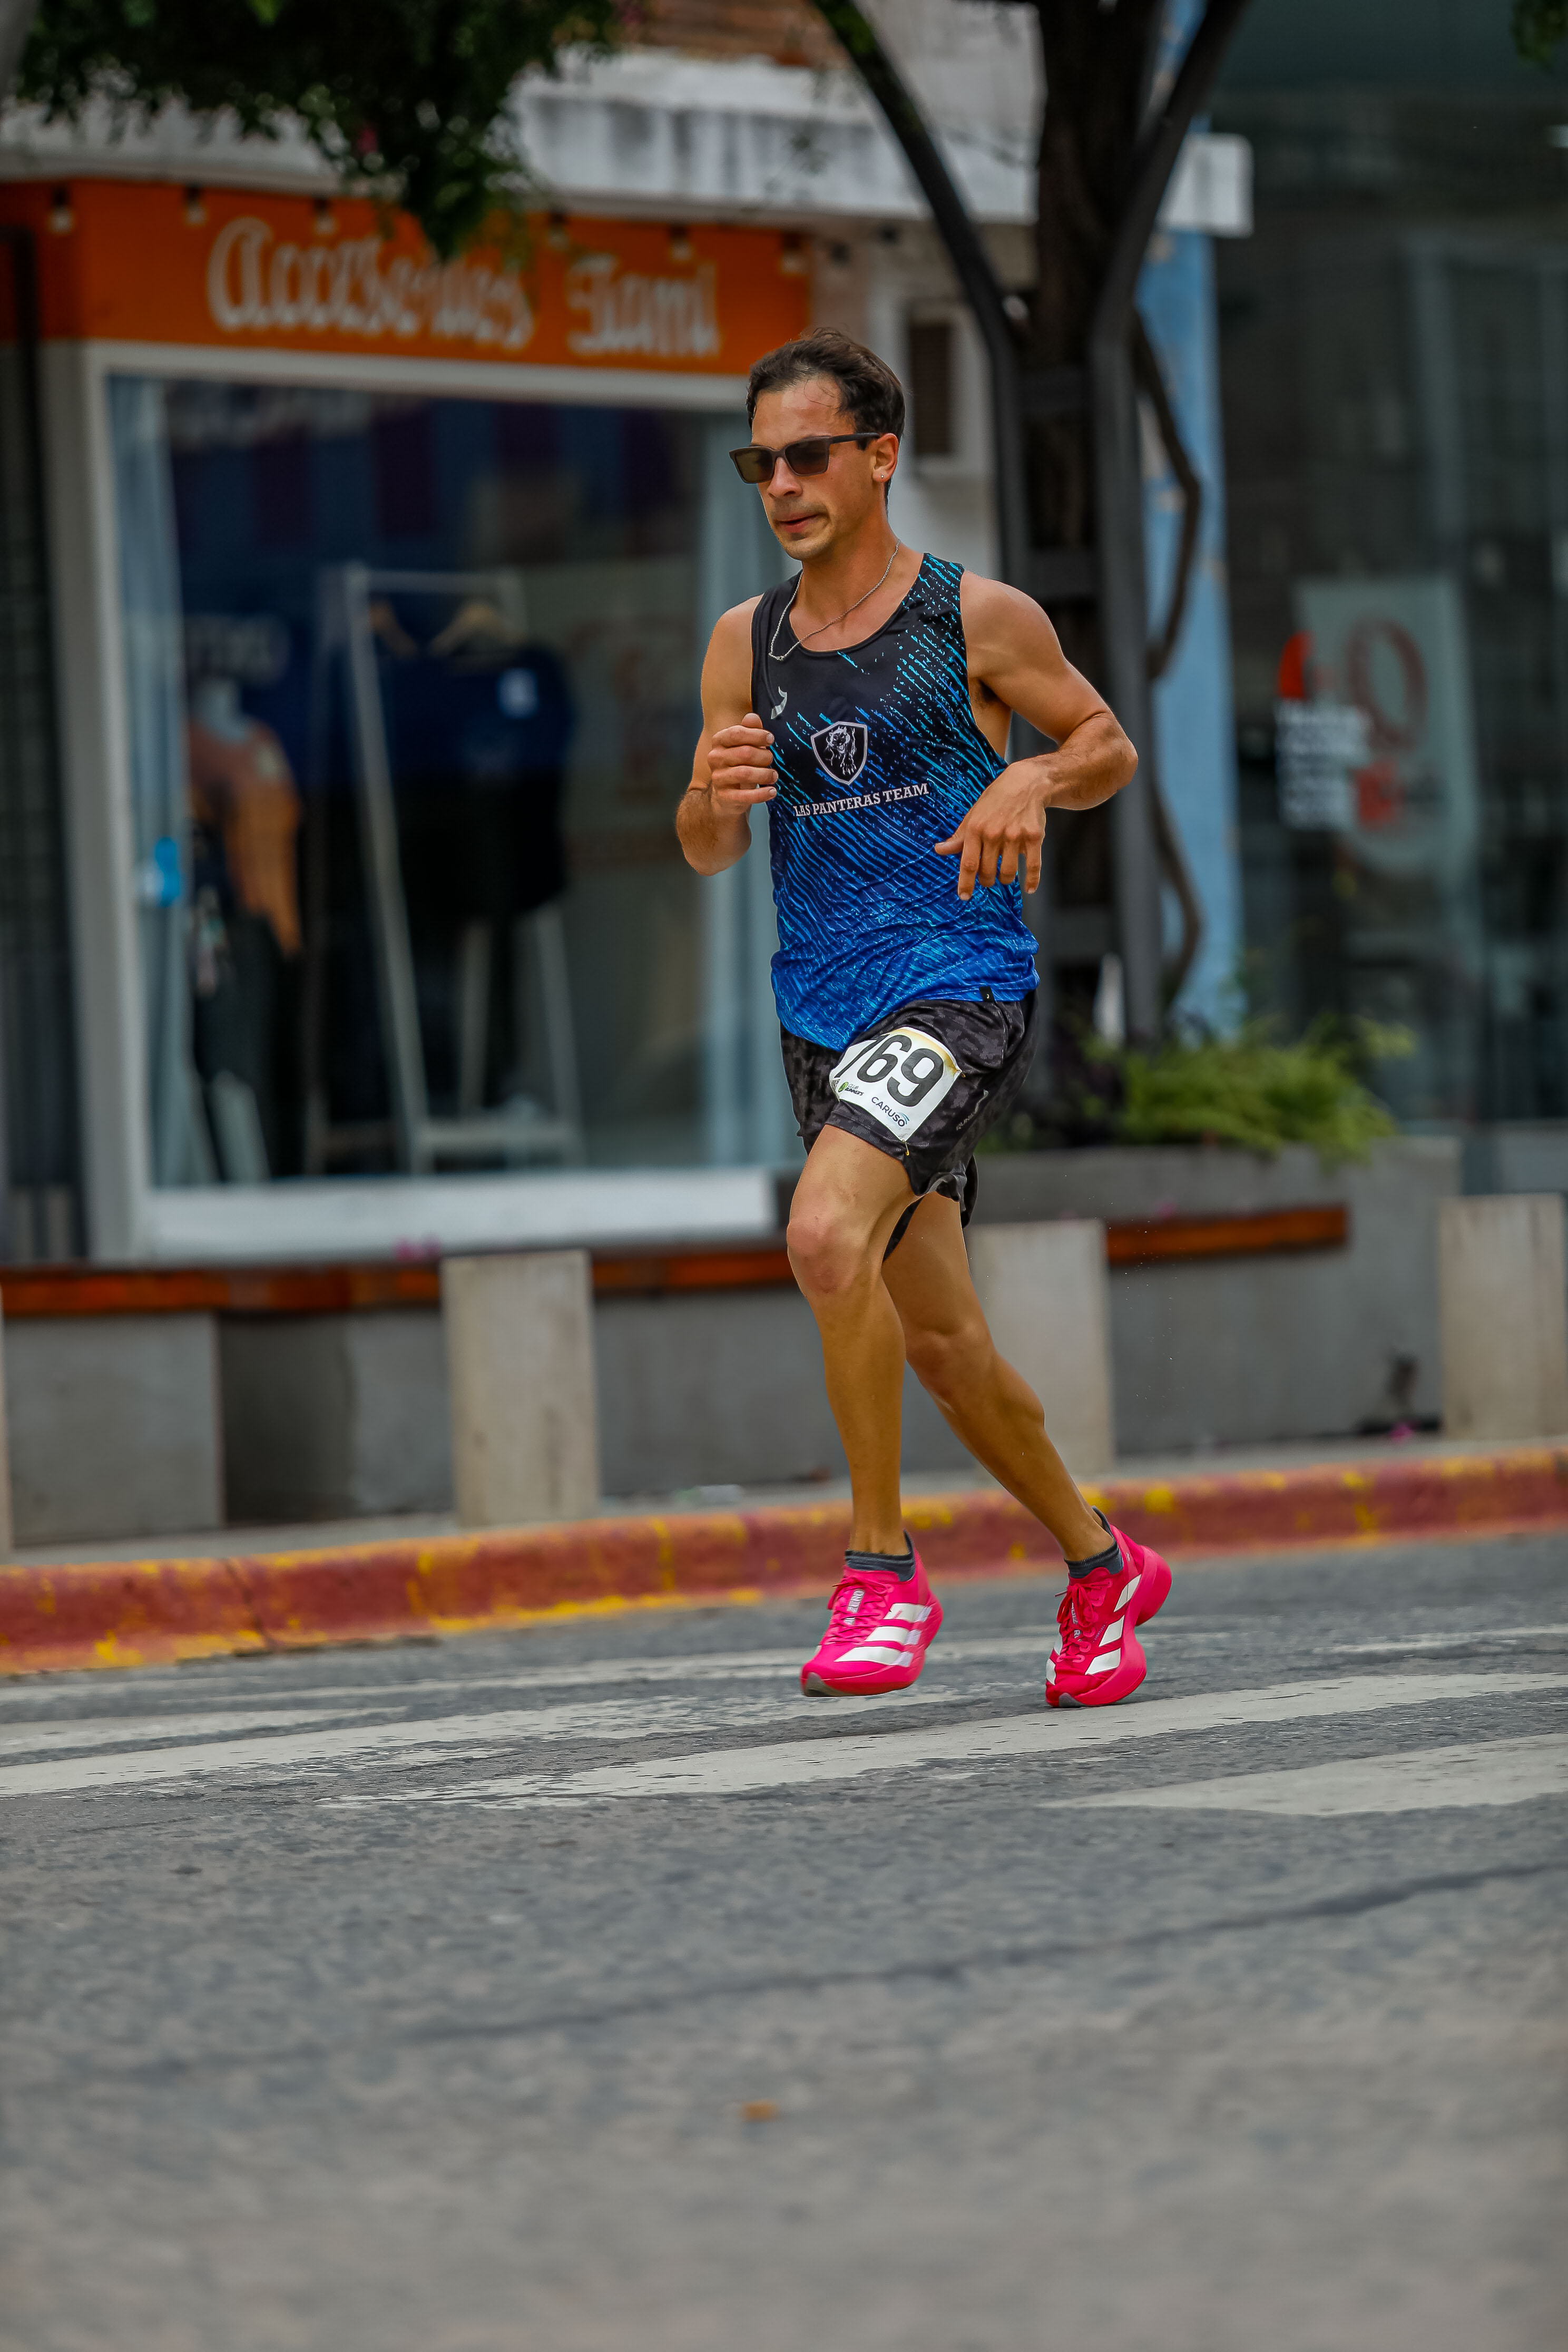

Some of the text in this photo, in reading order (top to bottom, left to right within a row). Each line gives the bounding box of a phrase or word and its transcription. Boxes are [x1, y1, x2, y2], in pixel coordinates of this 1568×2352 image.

[793, 783, 929, 816] LAS PANTERAS TEAM
[871, 1097, 905, 1126] CARUSO
